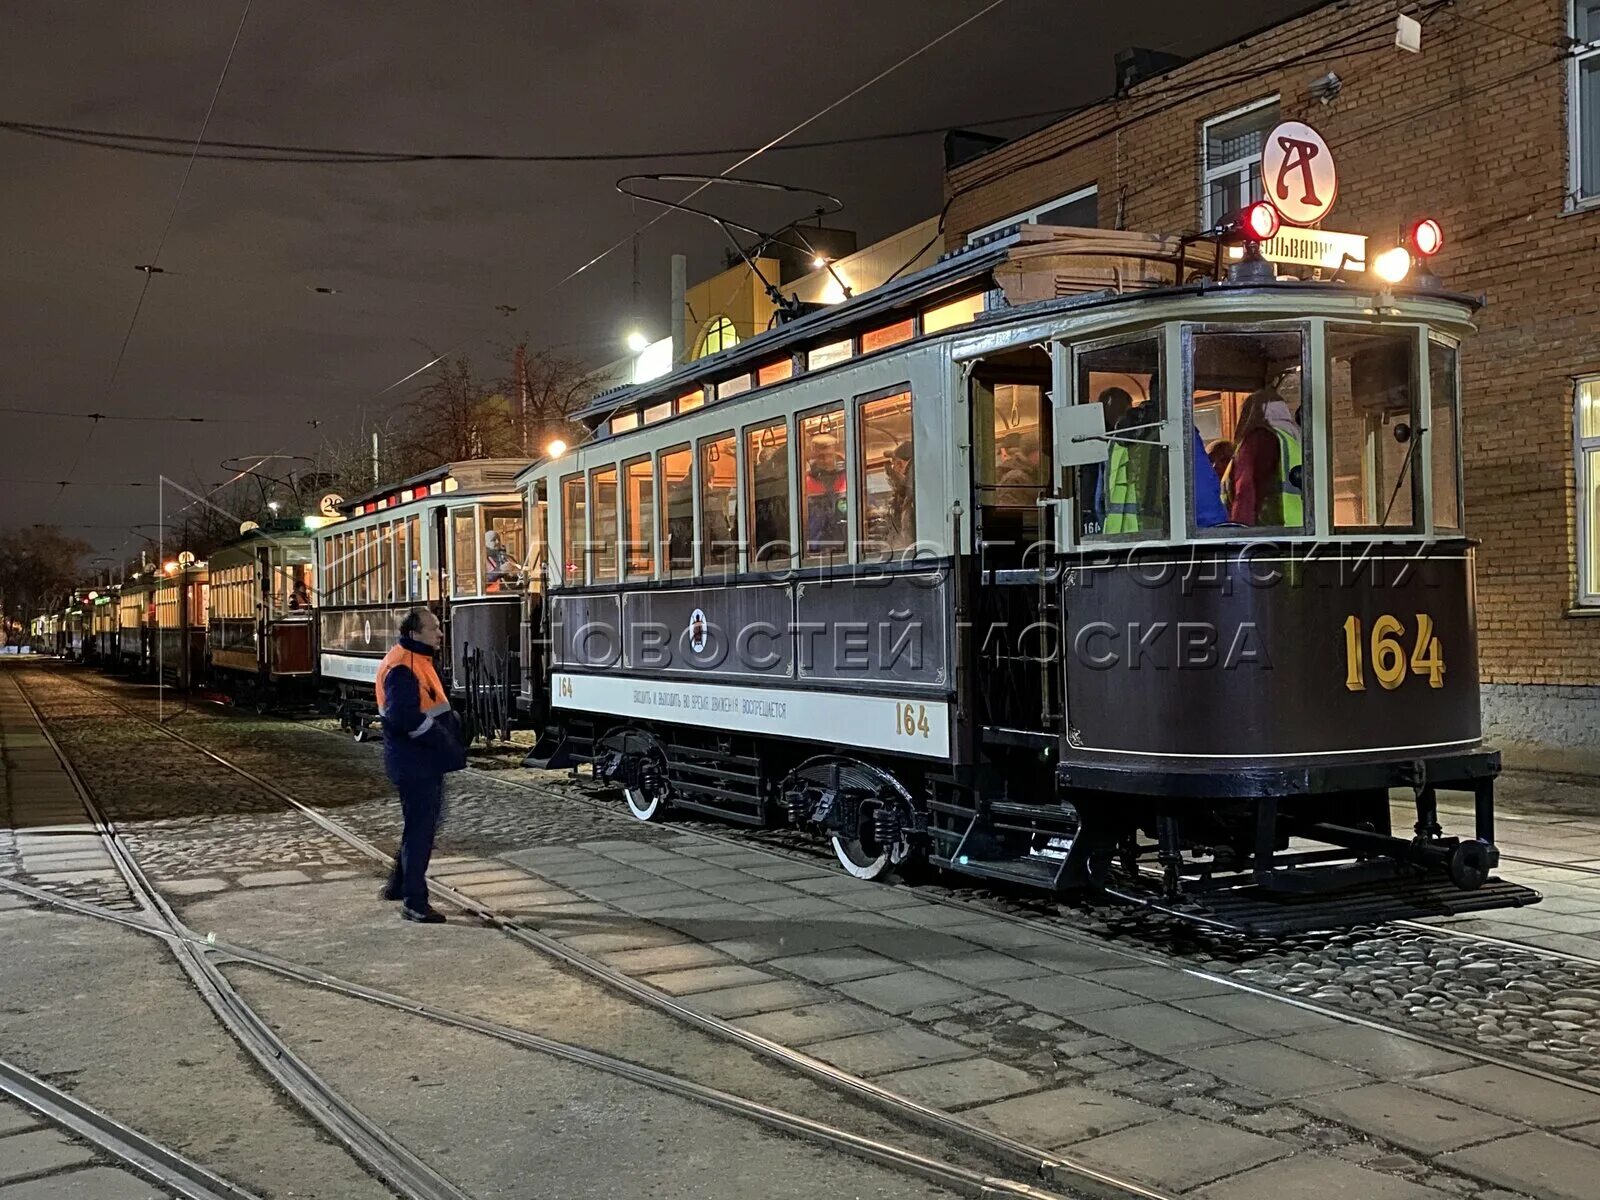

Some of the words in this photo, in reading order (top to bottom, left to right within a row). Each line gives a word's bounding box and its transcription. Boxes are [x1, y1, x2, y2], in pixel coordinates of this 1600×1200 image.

[1276, 136, 1323, 207] А
[1343, 613, 1447, 691] 164
[558, 676, 573, 699] 164
[896, 702, 930, 739] 164
